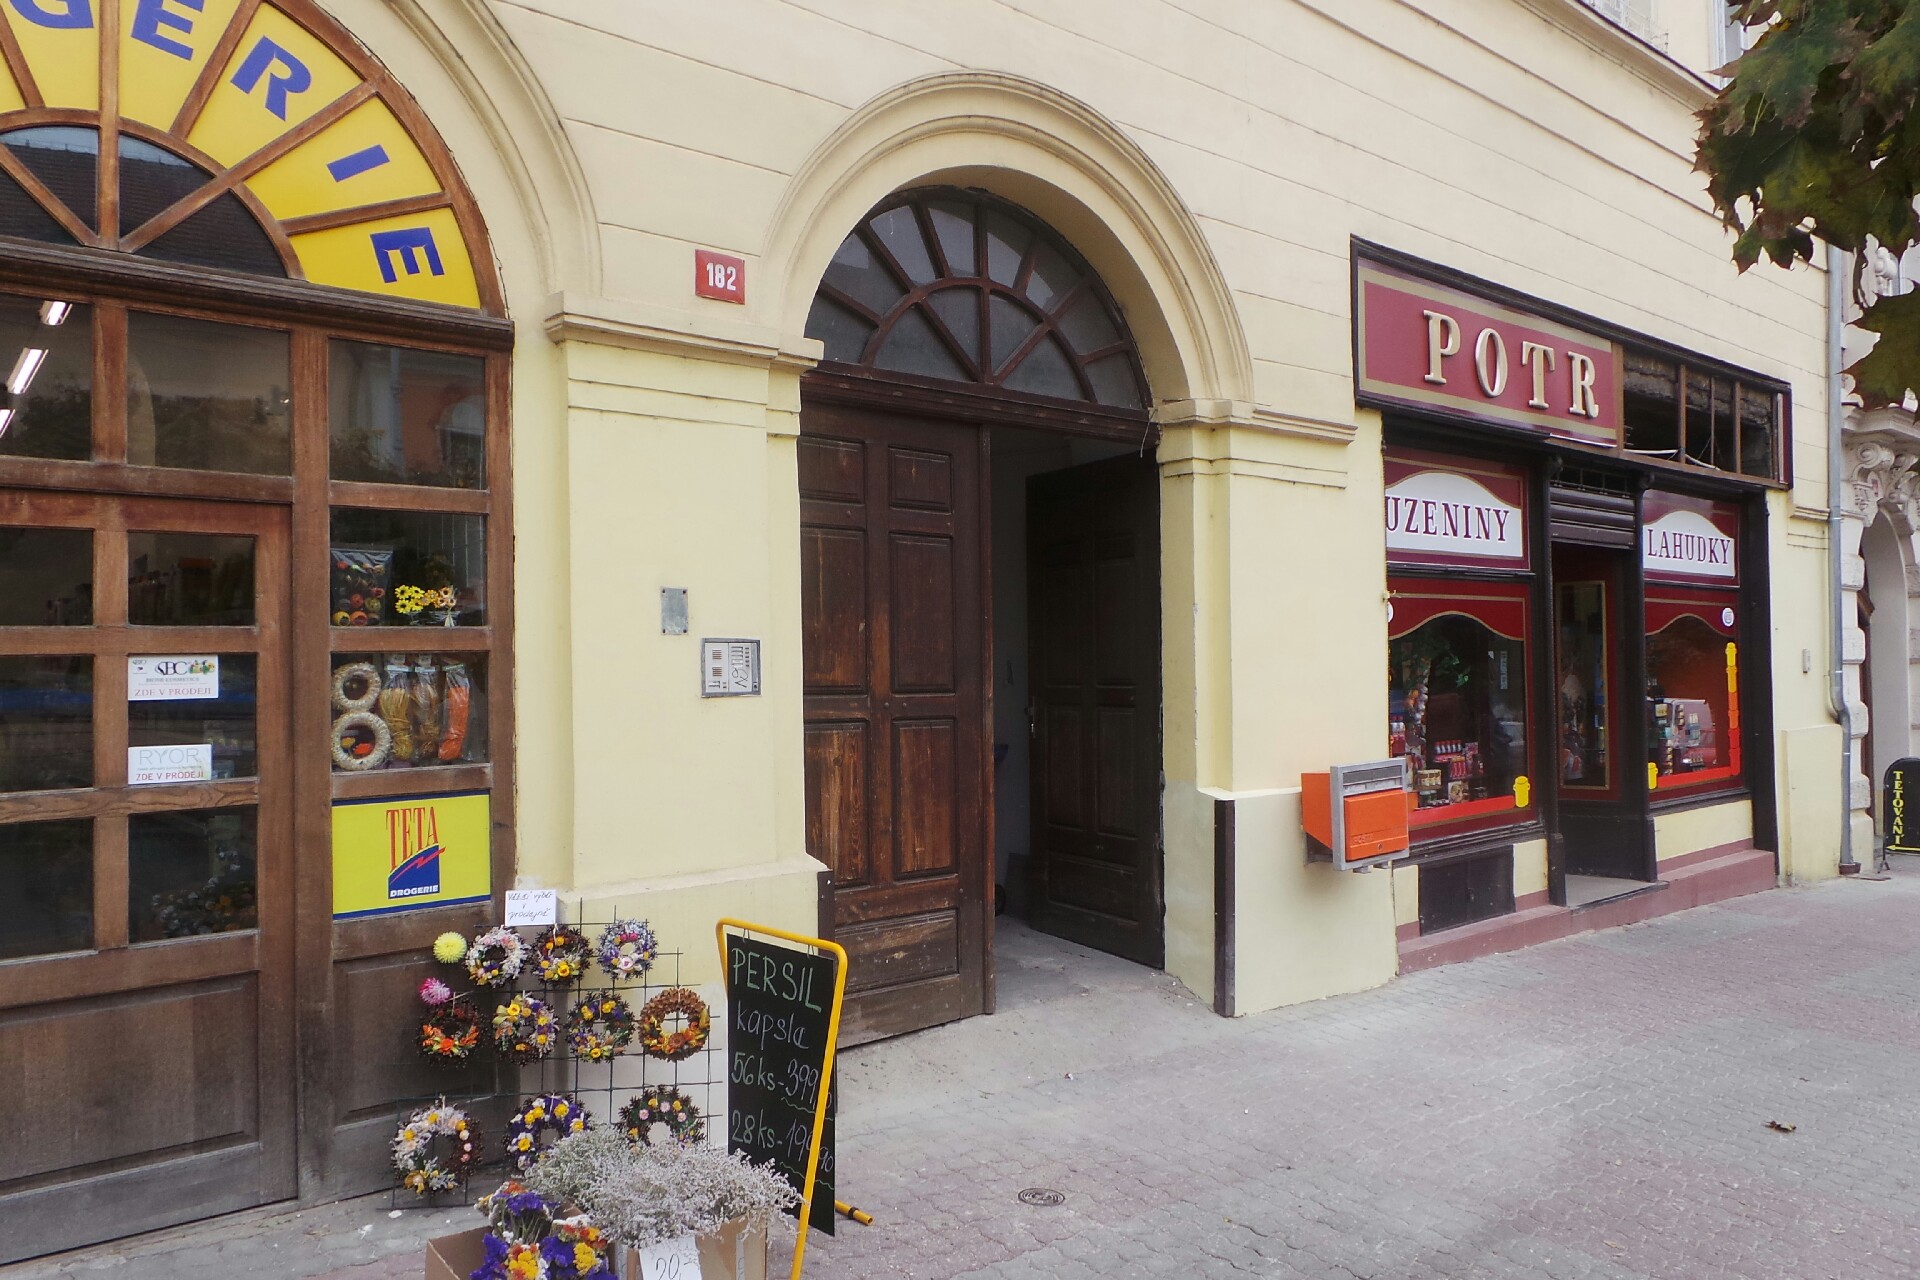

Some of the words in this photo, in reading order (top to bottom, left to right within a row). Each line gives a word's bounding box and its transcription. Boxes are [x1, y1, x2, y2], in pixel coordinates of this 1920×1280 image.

[707, 262, 736, 291] 182
[1423, 309, 1599, 419] POTR
[1385, 496, 1509, 541] UZENINY
[134, 688, 156, 697] ZDE
[159, 688, 166, 696] V
[168, 687, 212, 696] PRODEJI
[135, 772, 154, 781] ZDE
[156, 772, 163, 780] V
[165, 770, 205, 780] PRODEJI
[386, 807, 438, 873] TETA
[390, 884, 439, 897] DROGERIE
[731, 947, 822, 1014] PERSIL
